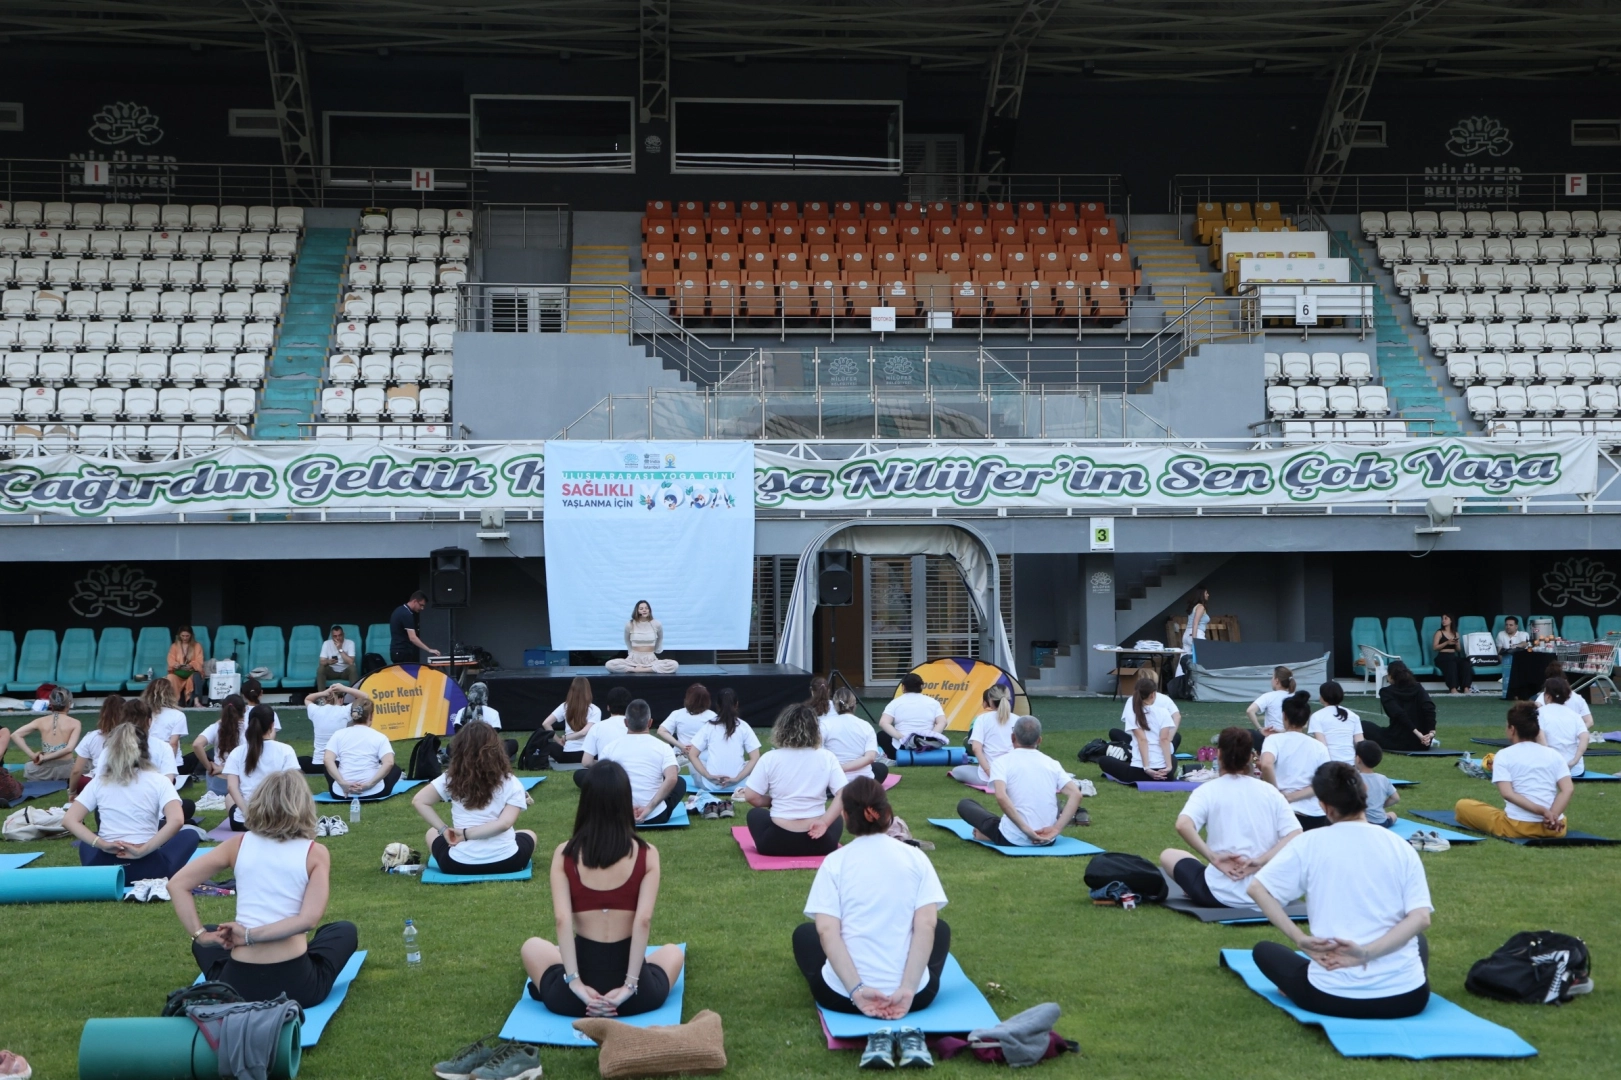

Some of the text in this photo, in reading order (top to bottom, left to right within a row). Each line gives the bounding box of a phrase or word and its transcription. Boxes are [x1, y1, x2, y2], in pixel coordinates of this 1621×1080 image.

[1424, 163, 1522, 181] NİLÜFER
[70, 173, 176, 188] BEDİYESİ
[415, 171, 430, 188] H
[1570, 177, 1582, 193] F
[1424, 184, 1520, 198] BELEDİYESİ
[1302, 304, 1310, 316] 6
[290, 460, 494, 499] Geldik
[843, 460, 1146, 500] Nilüfer'im
[1162, 460, 1269, 491] Sen
[1284, 457, 1394, 495] Çok
[1406, 449, 1556, 488] Yaşa
[562, 471, 736, 480] ULUSLARARASI YOGA GÜNÜ
[562, 480, 634, 497] SAĞLIKLI
[562, 498, 633, 509] YAŞLANMA İÇİN
[1097, 528, 1107, 541] 3
[920, 680, 970, 691] por Kenti
[371, 685, 423, 701] Spor Kenti
[375, 702, 411, 715] Nilüfer
